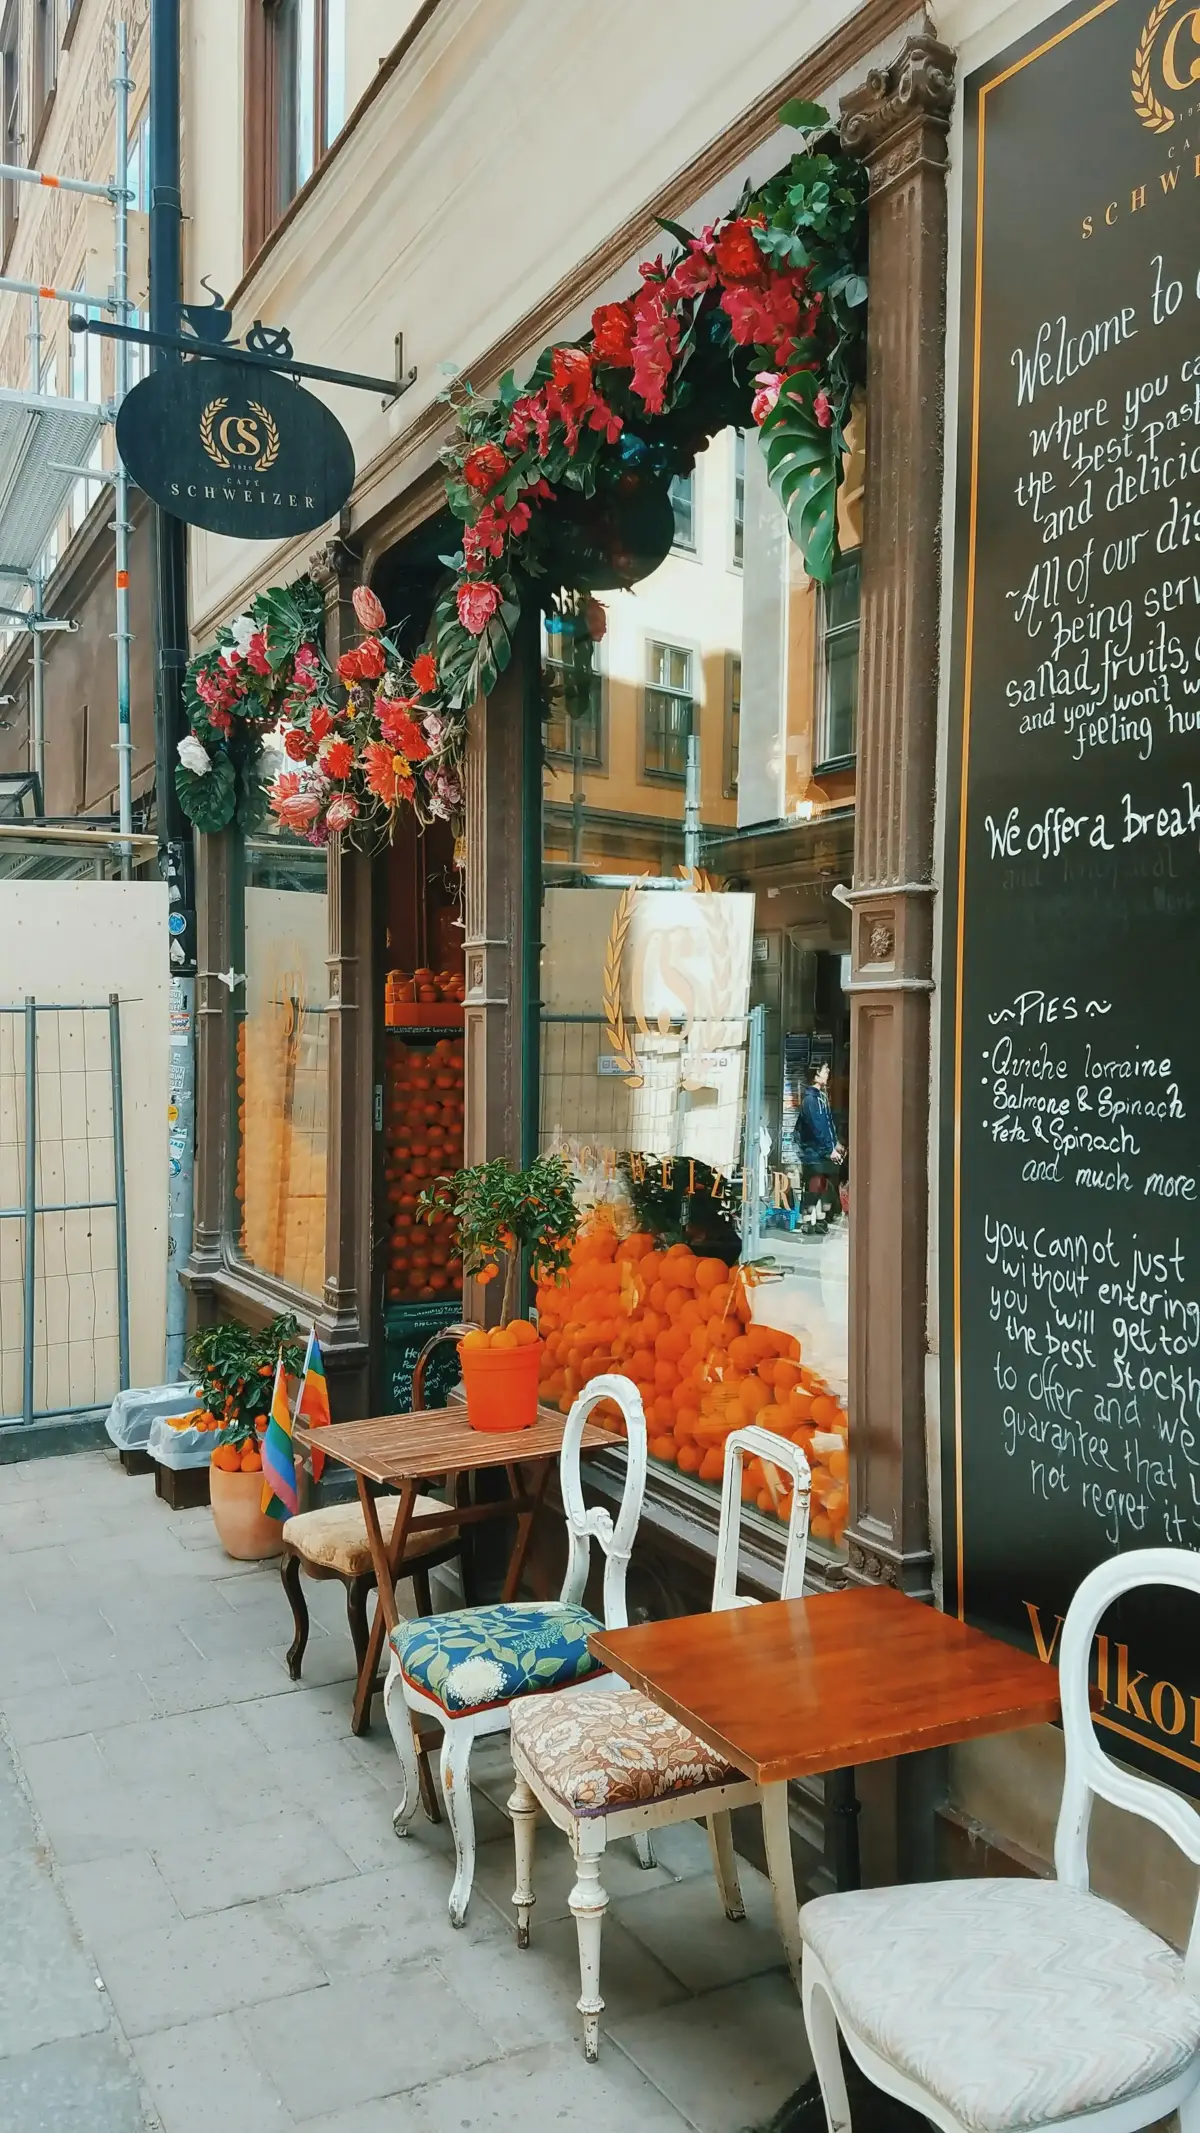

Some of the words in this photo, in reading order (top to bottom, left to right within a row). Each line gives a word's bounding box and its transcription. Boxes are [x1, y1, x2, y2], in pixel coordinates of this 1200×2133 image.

[1162, 8, 1200, 91] C
[1010, 307, 1138, 407] Welcome
[1150, 255, 1183, 325] to
[219, 416, 261, 456] CS
[1029, 398, 1109, 460] where
[1122, 375, 1169, 431] you
[171, 483, 315, 509] SCHWEIZER
[1015, 470, 1056, 523] the
[1069, 433, 1133, 487] best
[1042, 480, 1094, 544] and
[1067, 537, 1094, 605] of
[1103, 530, 1149, 575] our
[1051, 599, 1133, 663] being
[1019, 702, 1056, 734] and
[1064, 702, 1096, 735] you
[1114, 674, 1171, 711] won't
[1072, 713, 1153, 761] feeling
[1165, 703, 1200, 734] hu
[985, 807, 1021, 860] We
[1027, 807, 1089, 860] offer
[1089, 814, 1115, 850] a
[991, 1114, 1030, 1145] Feta
[1033, 1115, 1049, 1144] &
[1050, 1117, 1140, 1156] Spinach
[1077, 1086, 1094, 1112] &
[1098, 1082, 1187, 1123] Spinach
[1022, 1153, 1064, 1184] and
[1076, 1161, 1133, 1192] much
[1144, 1170, 1199, 1200] more
[984, 1215, 1029, 1264] you
[1127, 1233, 1185, 1291] just
[990, 1286, 1028, 1321] you
[1055, 1308, 1095, 1335] will
[1113, 1318, 1157, 1359] get
[1159, 1324, 1188, 1356] to
[1002, 1254, 1089, 1309] without
[1099, 1281, 1200, 1348] entering
[1006, 1315, 1042, 1356] the
[1046, 1321, 1096, 1369] best
[994, 1351, 1018, 1391] to
[1028, 1356, 1083, 1420] offer
[1094, 1393, 1142, 1430] and
[1003, 1405, 1119, 1472] guarantee
[1124, 1438, 1177, 1501] that
[1030, 1460, 1071, 1500] not
[1082, 1481, 1149, 1544] regret
[1163, 1499, 1187, 1542] it
[1021, 1600, 1200, 1749] Vlko
